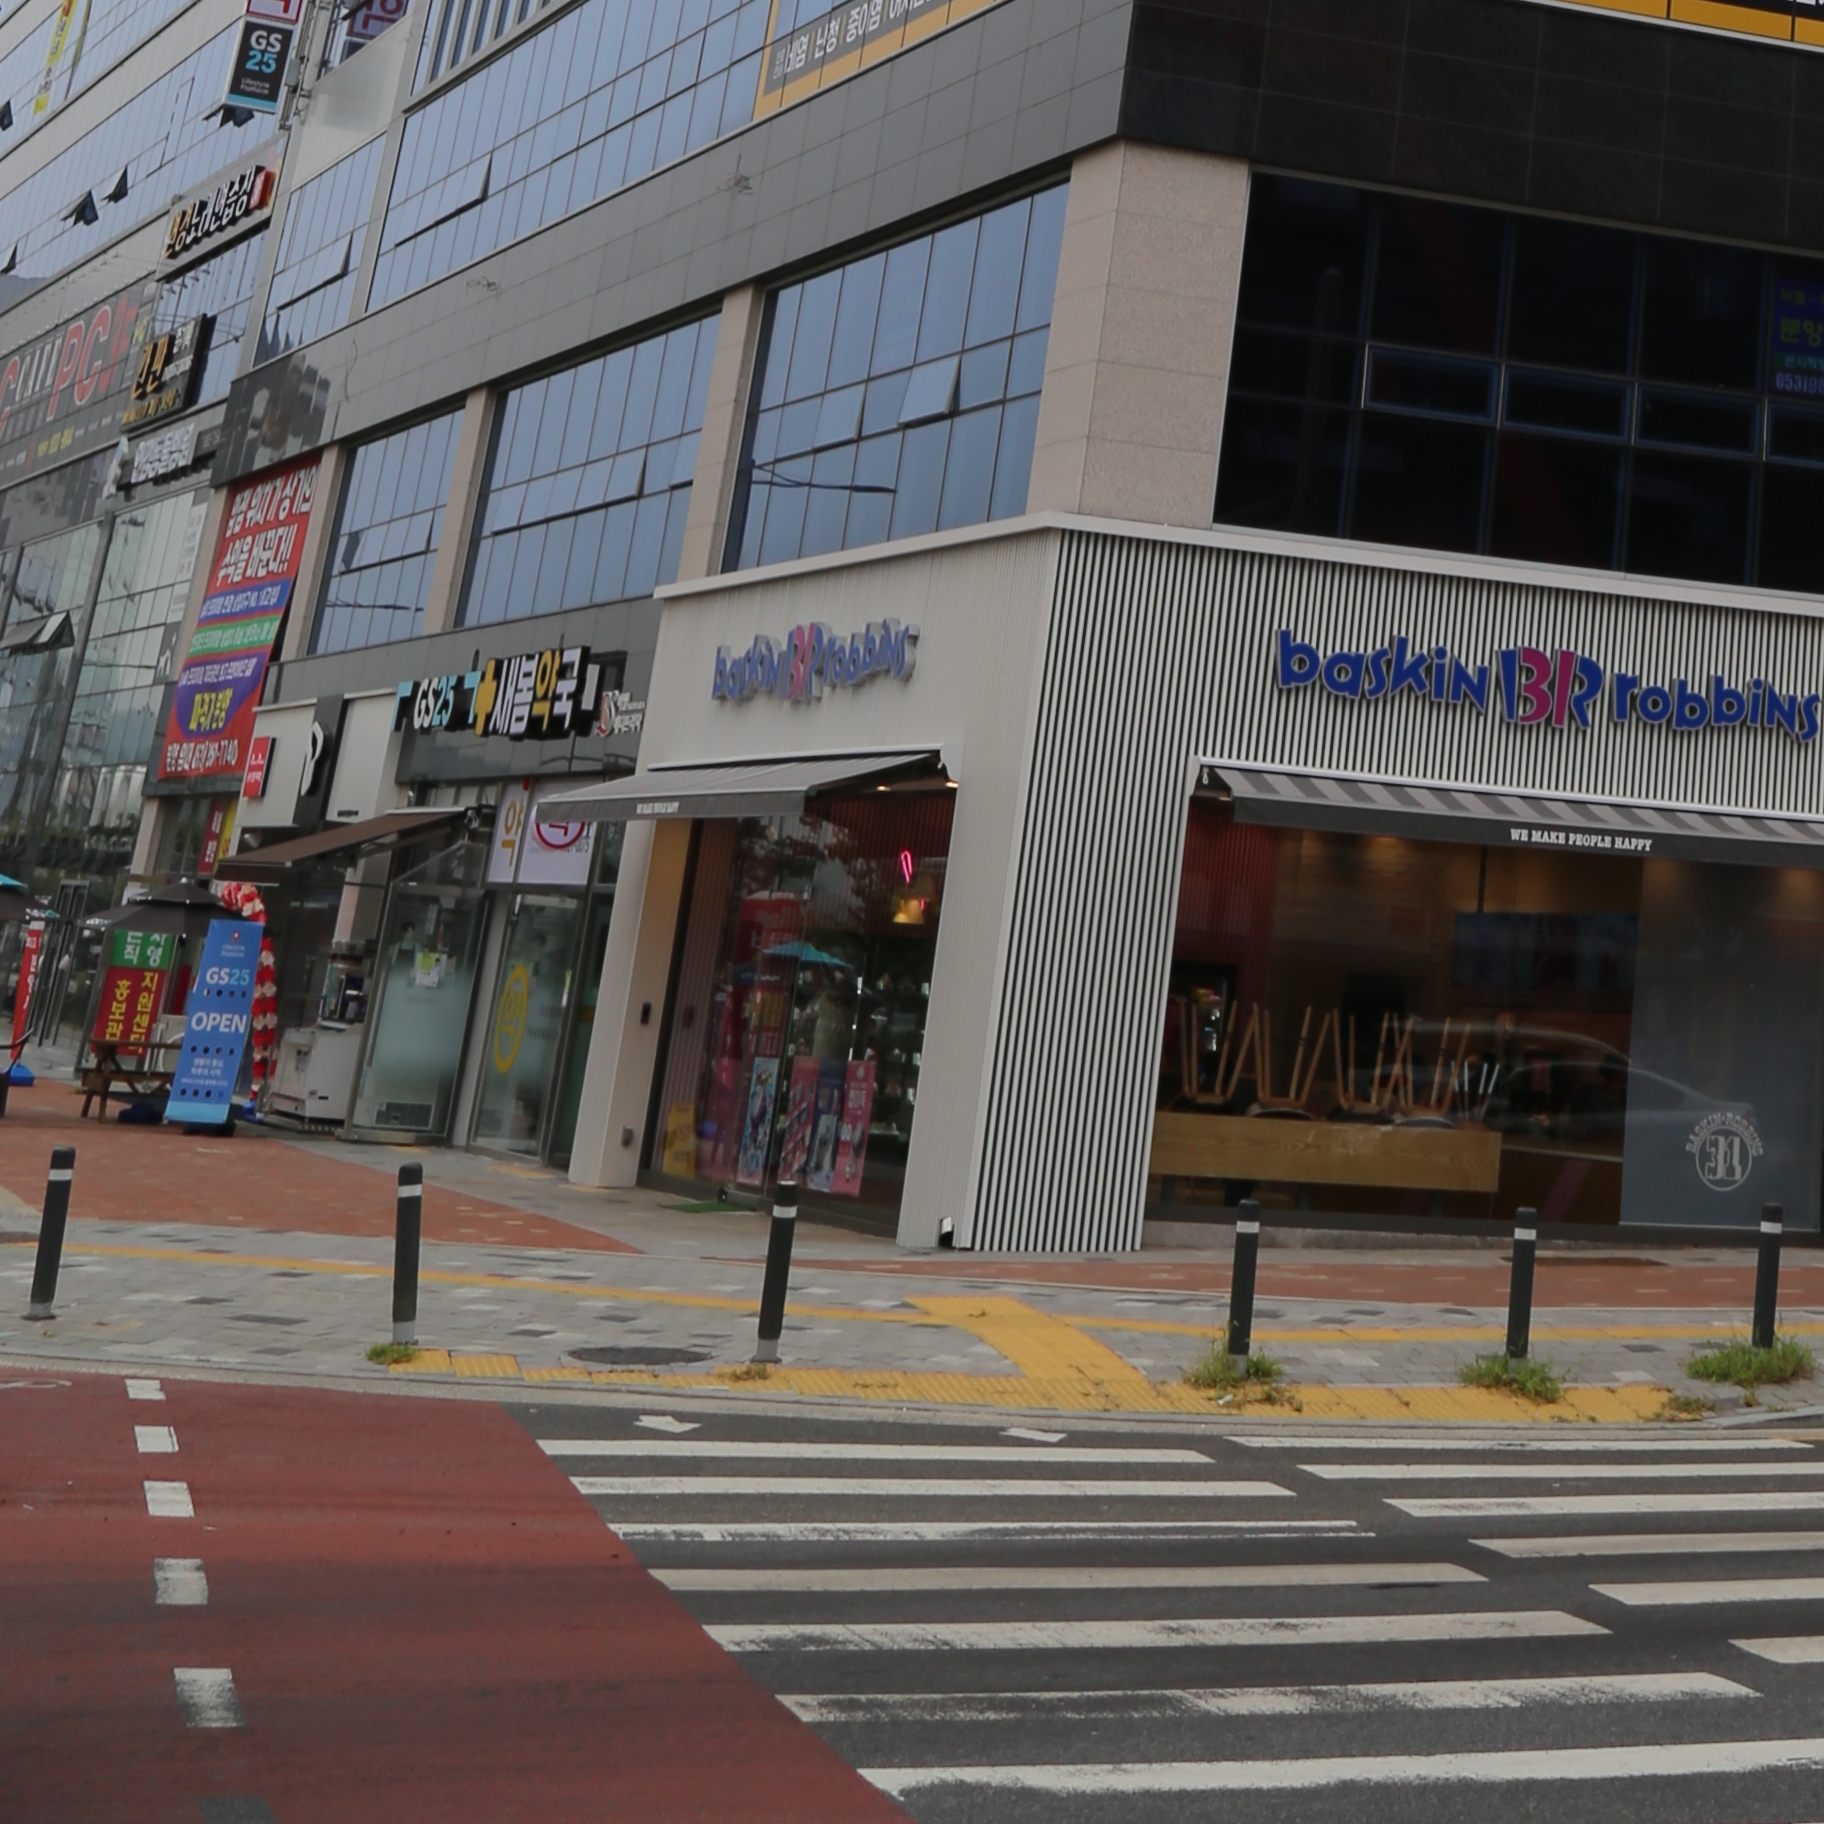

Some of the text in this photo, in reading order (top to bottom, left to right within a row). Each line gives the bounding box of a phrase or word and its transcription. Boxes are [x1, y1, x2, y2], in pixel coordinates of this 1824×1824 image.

[249, 29, 283, 53] GS
[246, 49, 278, 74] 25
[1780, 316, 1824, 348] 분양
[712, 617, 921, 702] baskin robbins
[413, 675, 457, 730] GS25
[489, 646, 582, 736] 새봄약국
[1275, 627, 1823, 744] baskin robbins
[1509, 827, 1653, 853] WE MAKE PEOPLE HAPPY
[205, 966, 251, 986] GS25
[104, 979, 132, 1043] 홍보관
[191, 1011, 248, 1034] OPEN
[1705, 1135, 1742, 1179] 31
